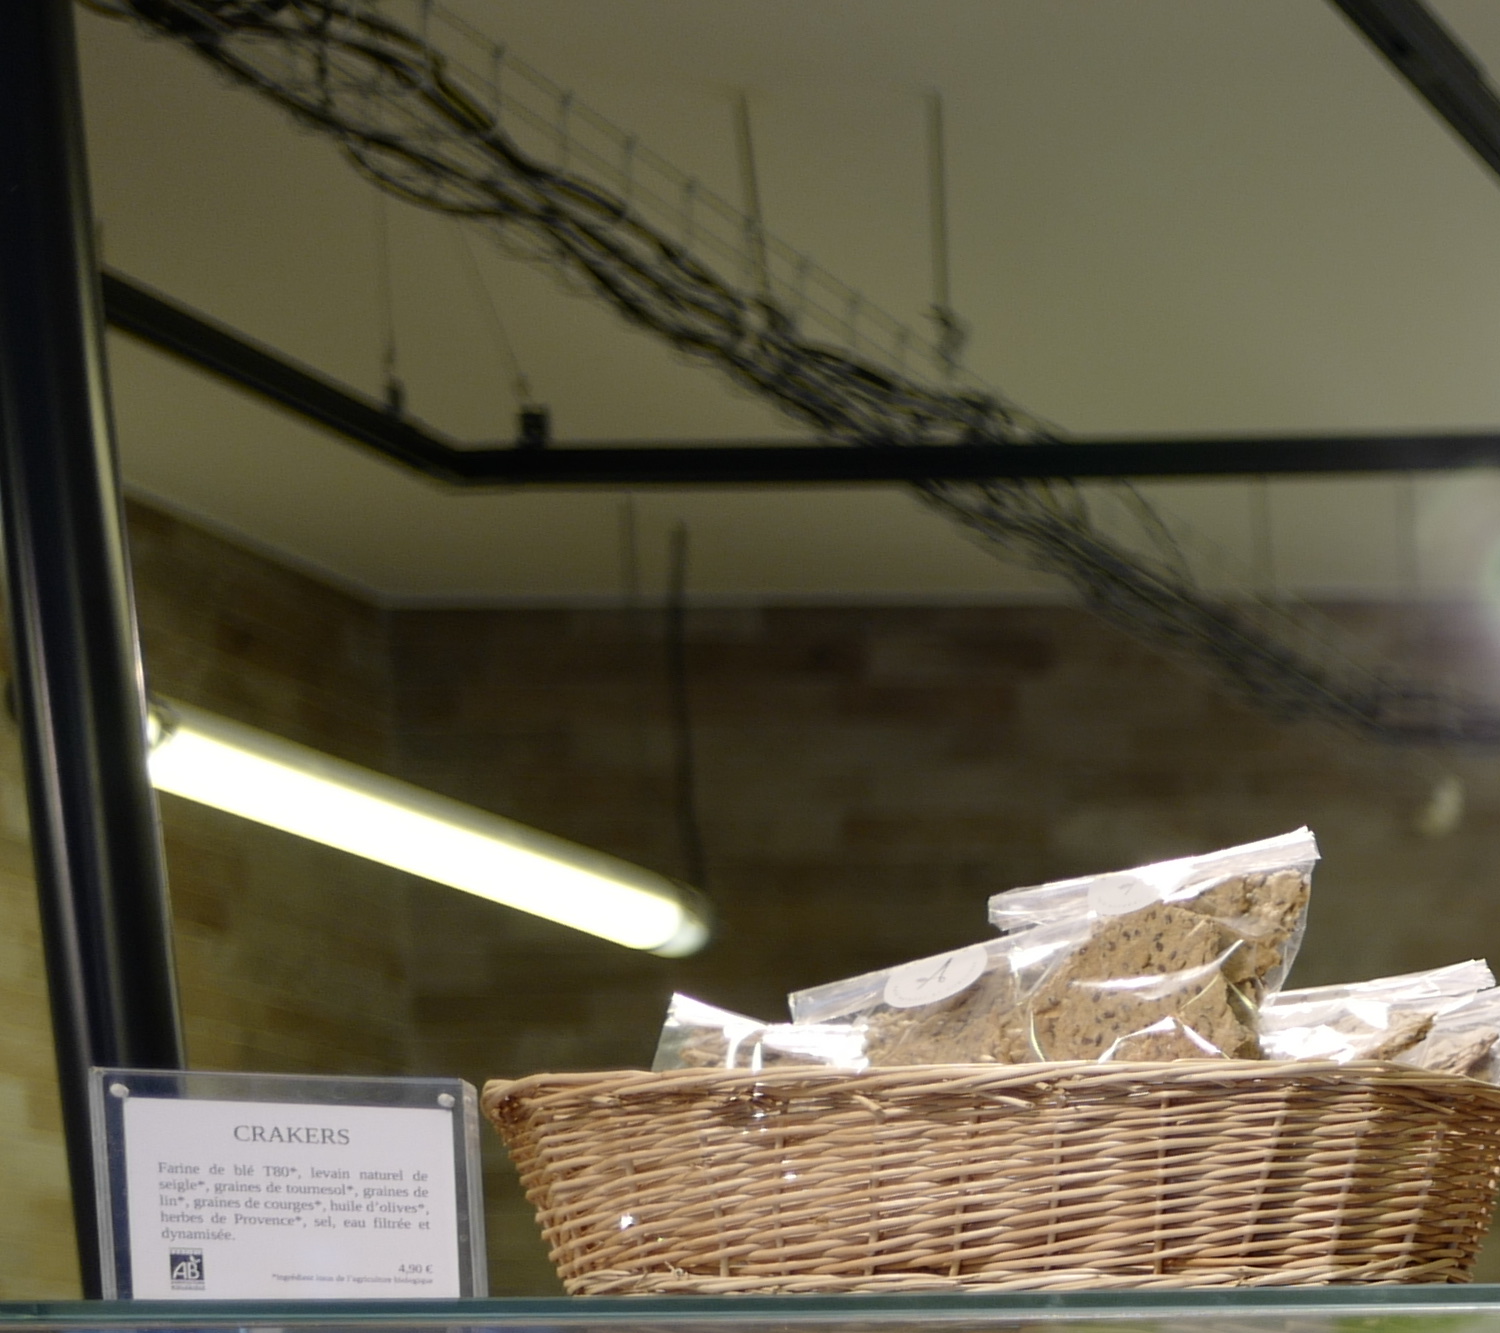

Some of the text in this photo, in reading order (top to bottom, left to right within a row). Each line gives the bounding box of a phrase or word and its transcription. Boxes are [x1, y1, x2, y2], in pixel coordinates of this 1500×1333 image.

[233, 1125, 350, 1146] CRAKERS
[158, 1162, 200, 1176] Farine
[208, 1163, 226, 1176] de
[233, 1163, 255, 1177] blé
[310, 1166, 351, 1180] levain
[359, 1169, 404, 1181] naturel
[412, 1170, 429, 1182] de
[160, 1227, 236, 1243] dynamisée.
